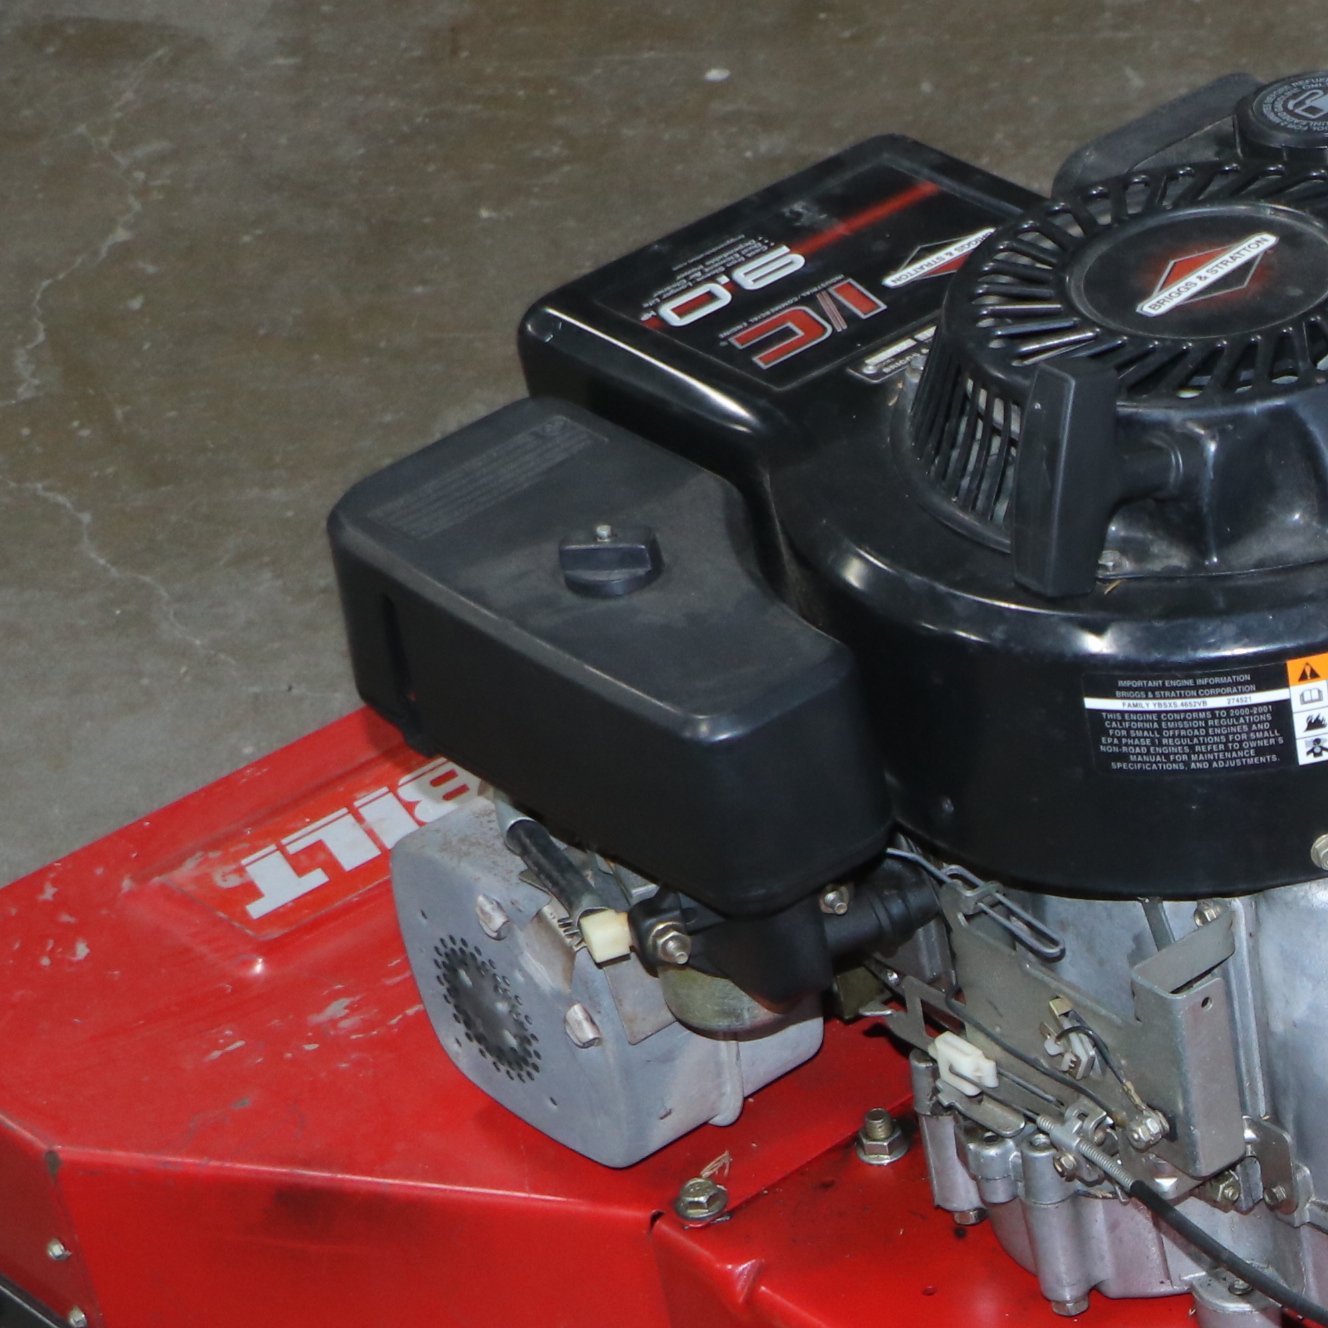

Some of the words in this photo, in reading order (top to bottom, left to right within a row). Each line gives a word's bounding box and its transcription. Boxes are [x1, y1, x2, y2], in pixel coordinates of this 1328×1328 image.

[703, 238, 757, 266] Dependable
[702, 252, 741, 272] Element
[888, 254, 947, 285] STRATTON
[1149, 281, 1197, 311] BRIGGS
[1206, 237, 1269, 275] STRATTON
[649, 243, 812, 329] 9.0
[637, 310, 656, 321] HP
[724, 277, 890, 369] I/C
[1118, 678, 1162, 688] IMPORTANT
[1165, 678, 1194, 686] ENGINE
[1196, 674, 1250, 684] INFORMATION
[1115, 689, 1145, 698] BRIGGS
[1155, 688, 1196, 698] STRATTON
[1198, 684, 1255, 695] CORPORATION
[1122, 701, 1149, 709] FAMILY
[1227, 696, 1251, 704] 274521
[1101, 712, 1122, 721] THIS
[1125, 712, 1157, 721] ENGINE
[1161, 711, 1211, 720] CONFORMS
[1230, 705, 1271, 716] 2000-2001
[1105, 719, 1158, 730] CALIFORNIA
[1162, 719, 1204, 728] EMISSION
[1208, 713, 1271, 726] REGULATIONS
[1109, 729, 1127, 737] FOR
[1130, 728, 1159, 738] SMALL
[1163, 727, 1205, 736] OFFROAD
[1209, 724, 1248, 733] ENGINES
[1251, 722, 1269, 730] AND
[1122, 737, 1151, 746] PHASE
[1162, 735, 1225, 745] REGULATIONS
[1229, 733, 1246, 741] FOR
[1250, 729, 1279, 738] SMALL
[1100, 743, 1147, 755] NON-ROAD
[1195, 743, 1224, 751] REFER
[1242, 737, 1283, 748] OWNER'S
[1130, 753, 1167, 763] MANUAL
[1170, 753, 1188, 761] FOR
[1191, 749, 1255, 760] MAINTENANCE
[1190, 761, 1209, 769] AND
[1212, 755, 1279, 767] ADJUSTMENTS.
